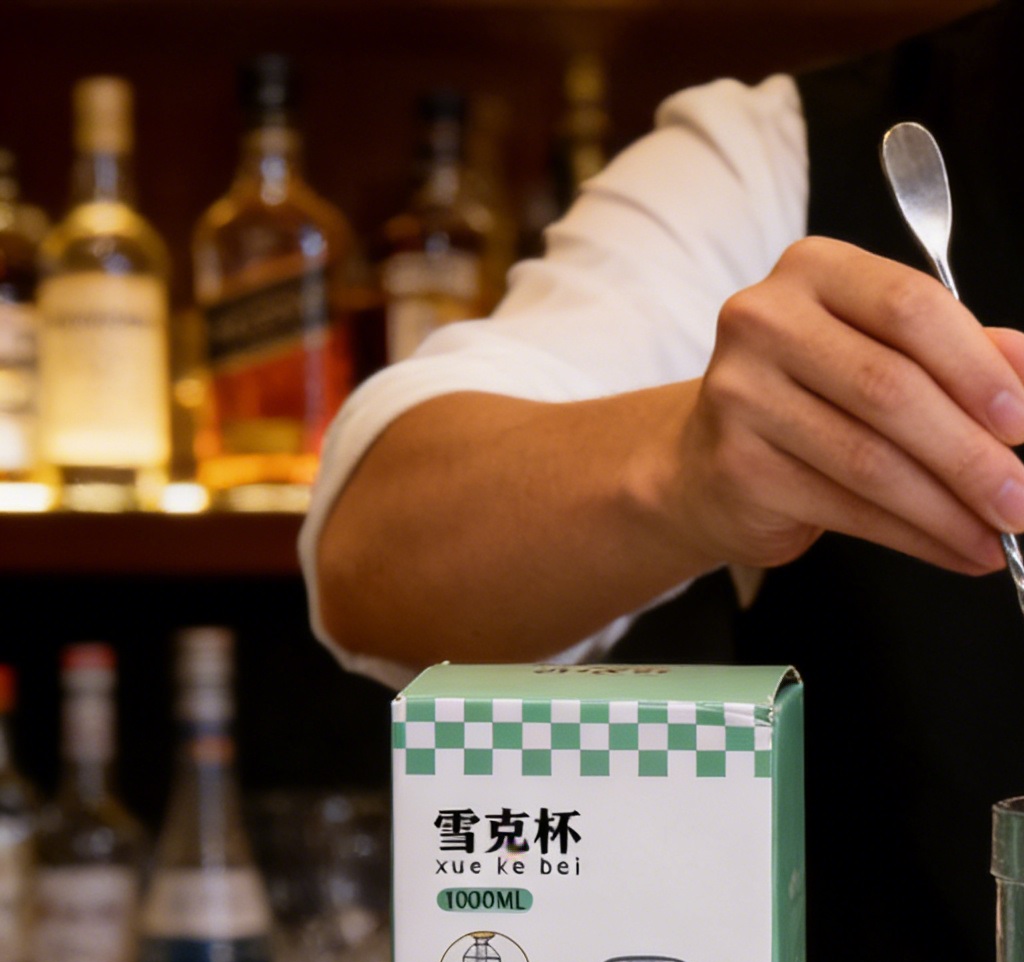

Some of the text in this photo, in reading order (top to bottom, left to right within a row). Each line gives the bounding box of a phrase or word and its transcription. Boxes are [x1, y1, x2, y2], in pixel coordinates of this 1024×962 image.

[434, 808, 582, 854] 雪克杯
[436, 857, 580, 876] xue ke bei
[446, 890, 526, 910] 1000ML
